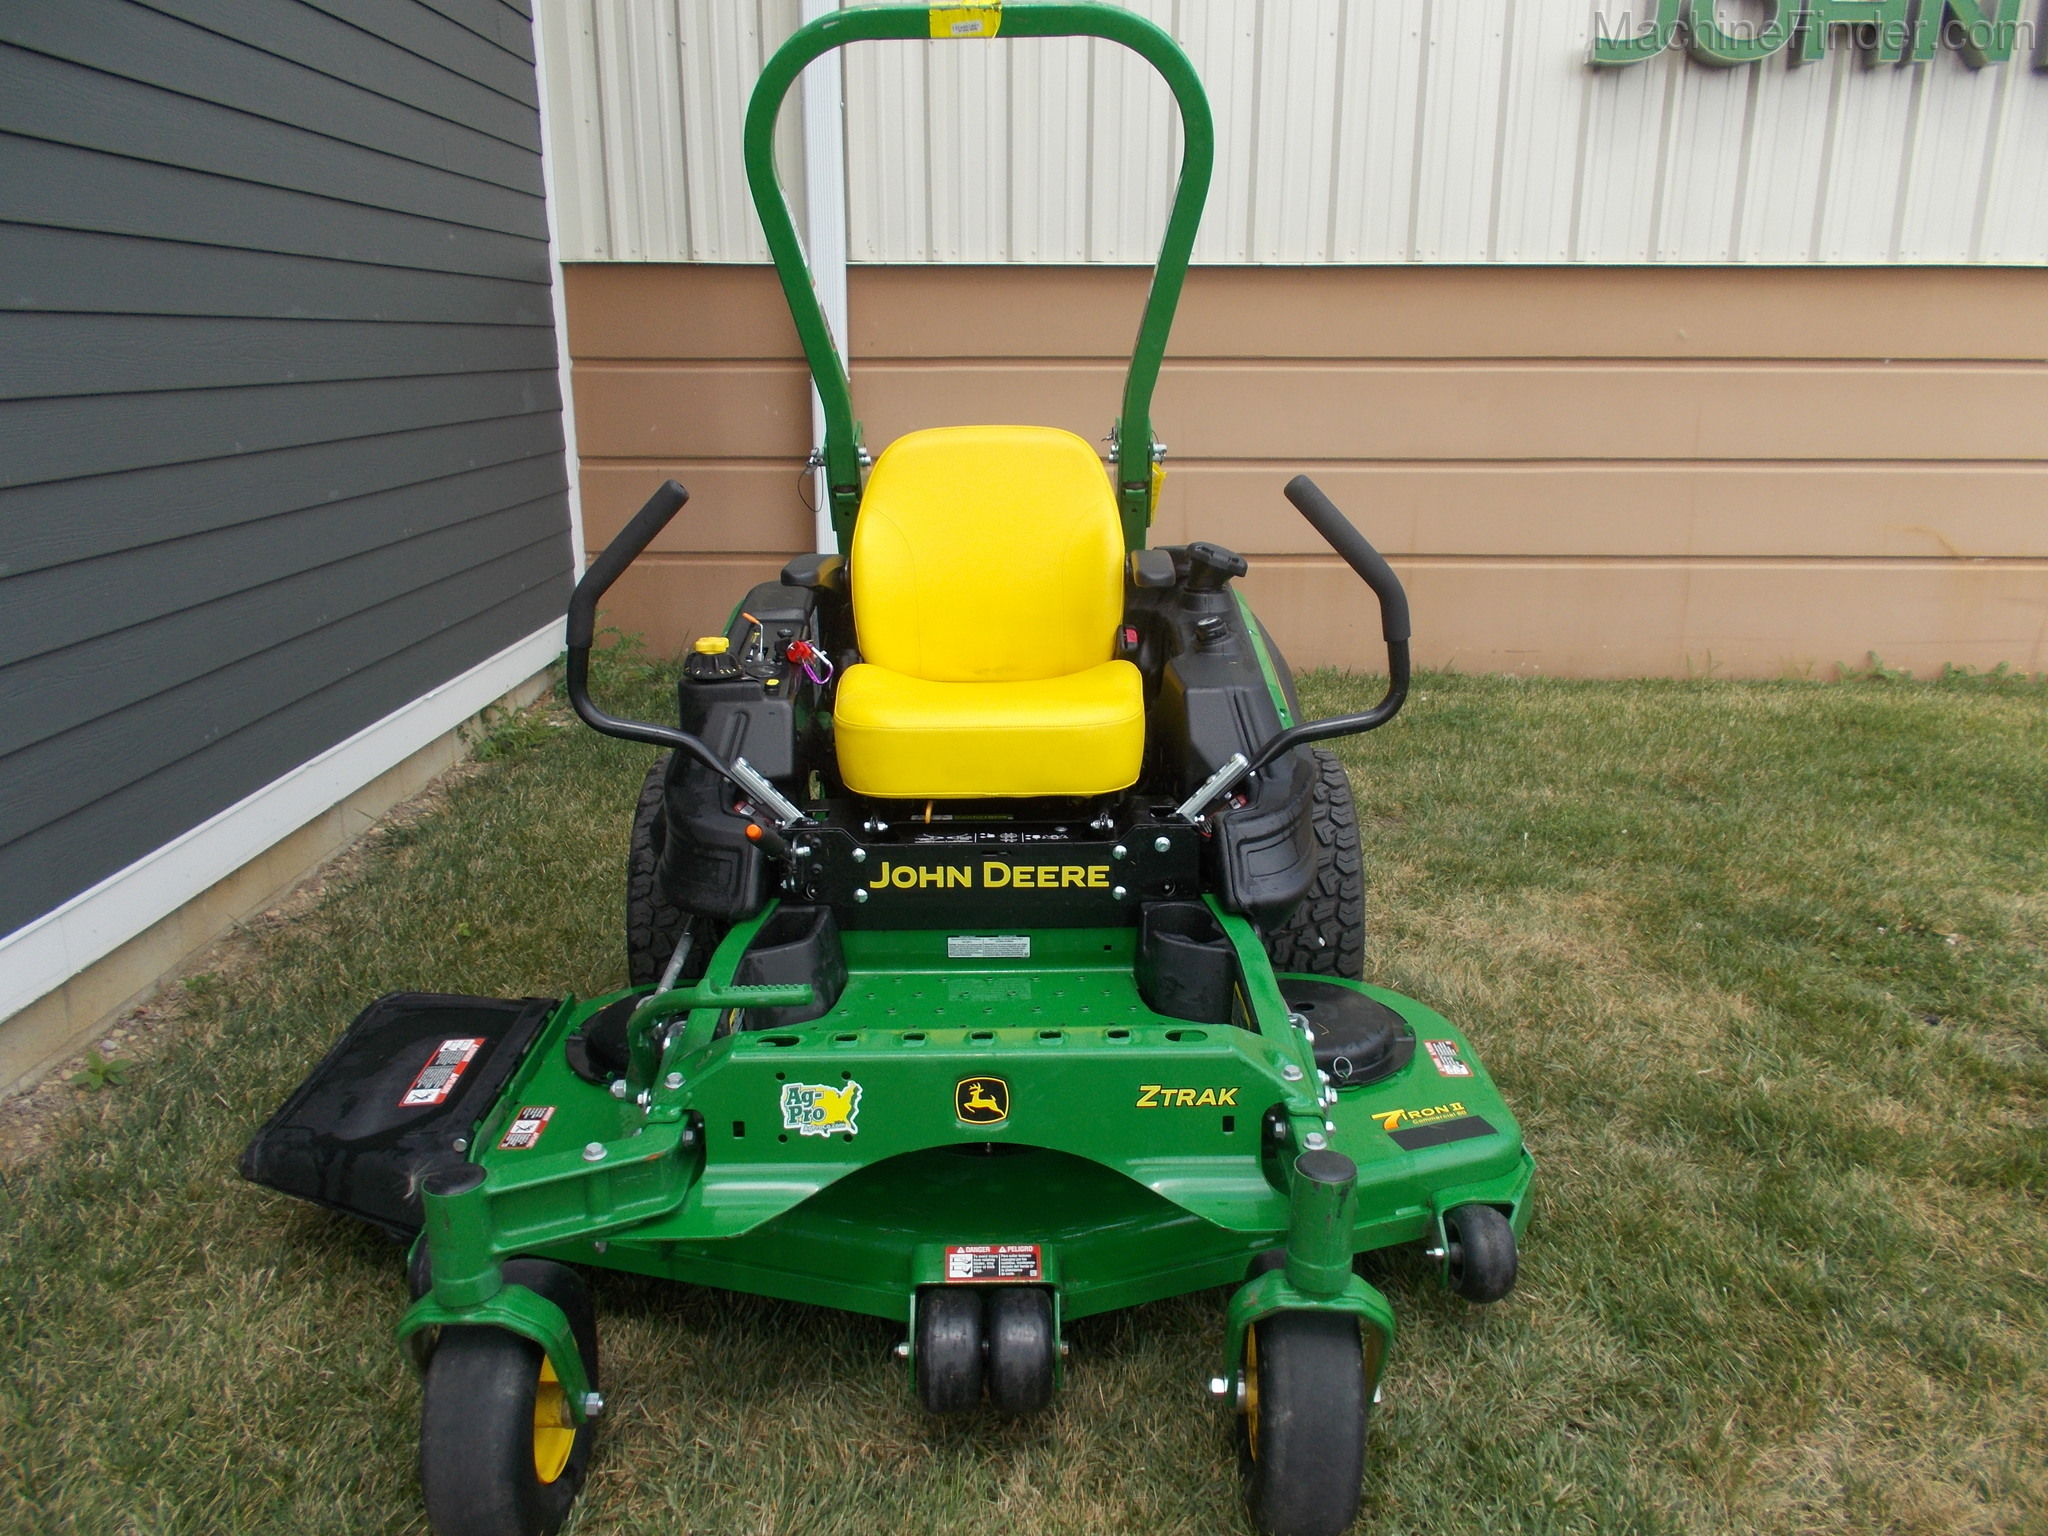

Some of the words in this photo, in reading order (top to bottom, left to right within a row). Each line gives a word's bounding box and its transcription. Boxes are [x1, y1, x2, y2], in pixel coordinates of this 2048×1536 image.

[869, 861, 972, 888] JOHN
[983, 861, 1110, 888] DEERE
[1136, 1085, 1240, 1107] ZTRAK
[786, 1104, 826, 1124] Pro
[1007, 1245, 1034, 1253] PELIGRO
